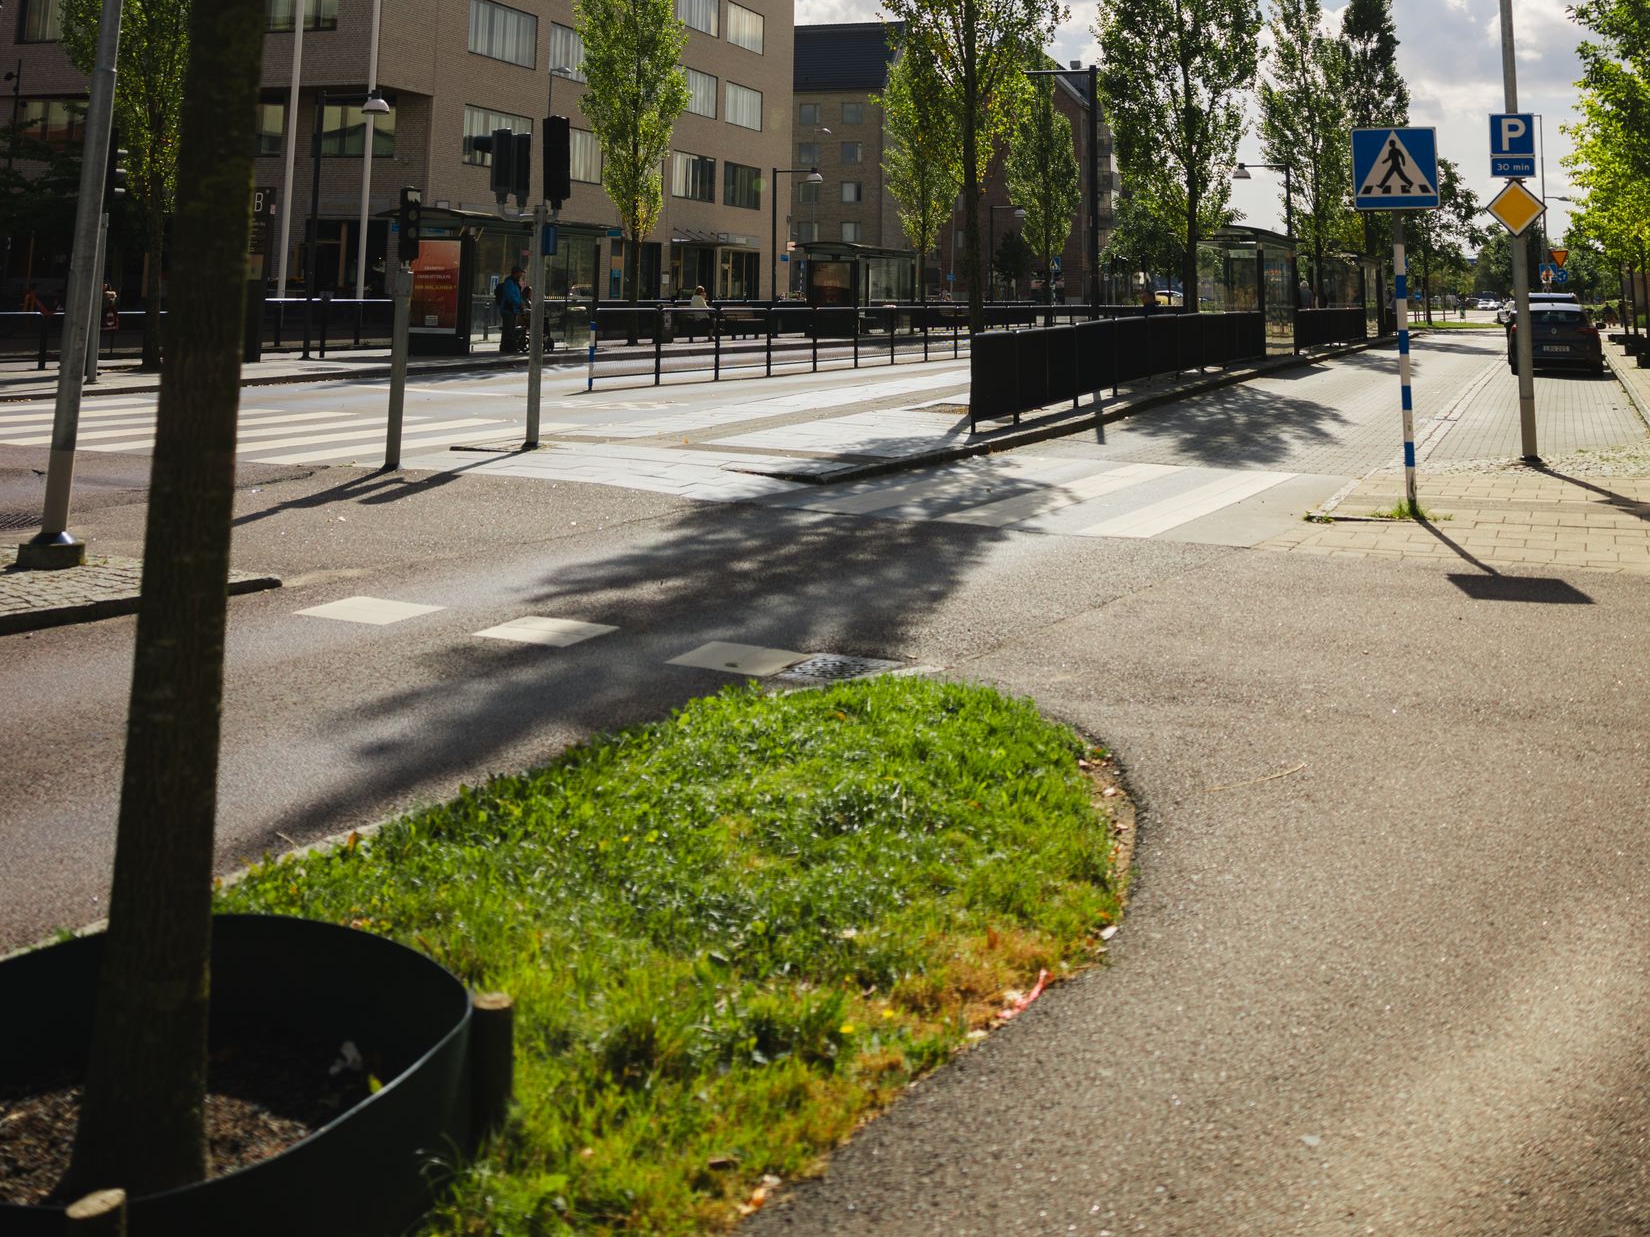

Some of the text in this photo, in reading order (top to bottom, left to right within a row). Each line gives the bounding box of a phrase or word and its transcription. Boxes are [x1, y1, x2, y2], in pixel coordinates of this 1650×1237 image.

[1501, 118, 1526, 152] P
[1497, 163, 1530, 171] 30 min
